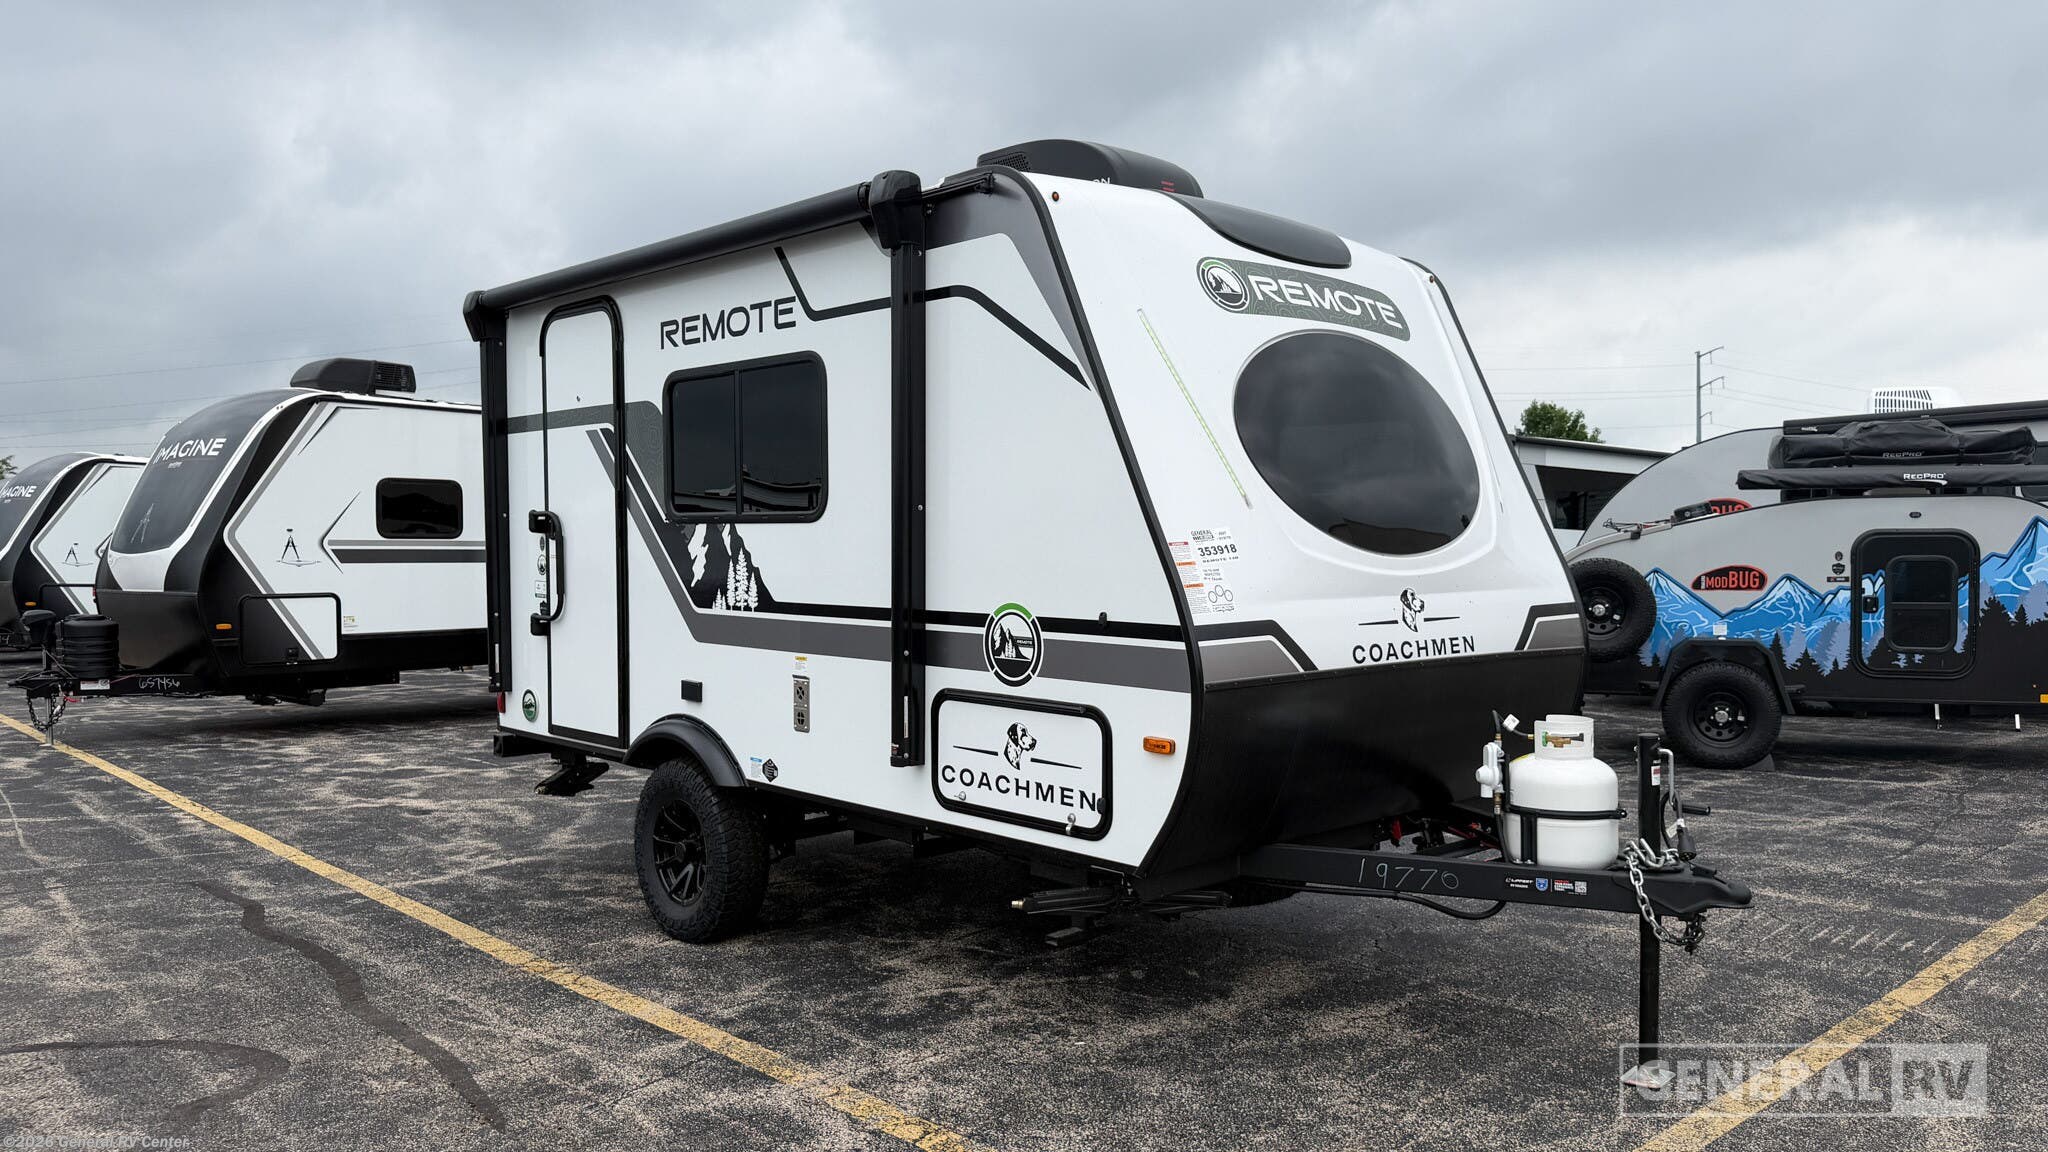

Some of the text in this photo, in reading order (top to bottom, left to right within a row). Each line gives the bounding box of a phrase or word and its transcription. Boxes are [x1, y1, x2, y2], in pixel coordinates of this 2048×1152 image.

[1248, 274, 1403, 328] REMOTE
[660, 296, 797, 350] REMOTE
[152, 437, 228, 465] IMAGINE
[1197, 543, 1238, 557] 353918
[1353, 636, 1475, 665] COACHMEN
[942, 764, 1098, 812] COACHMEN
[1358, 857, 1460, 891] 19770
